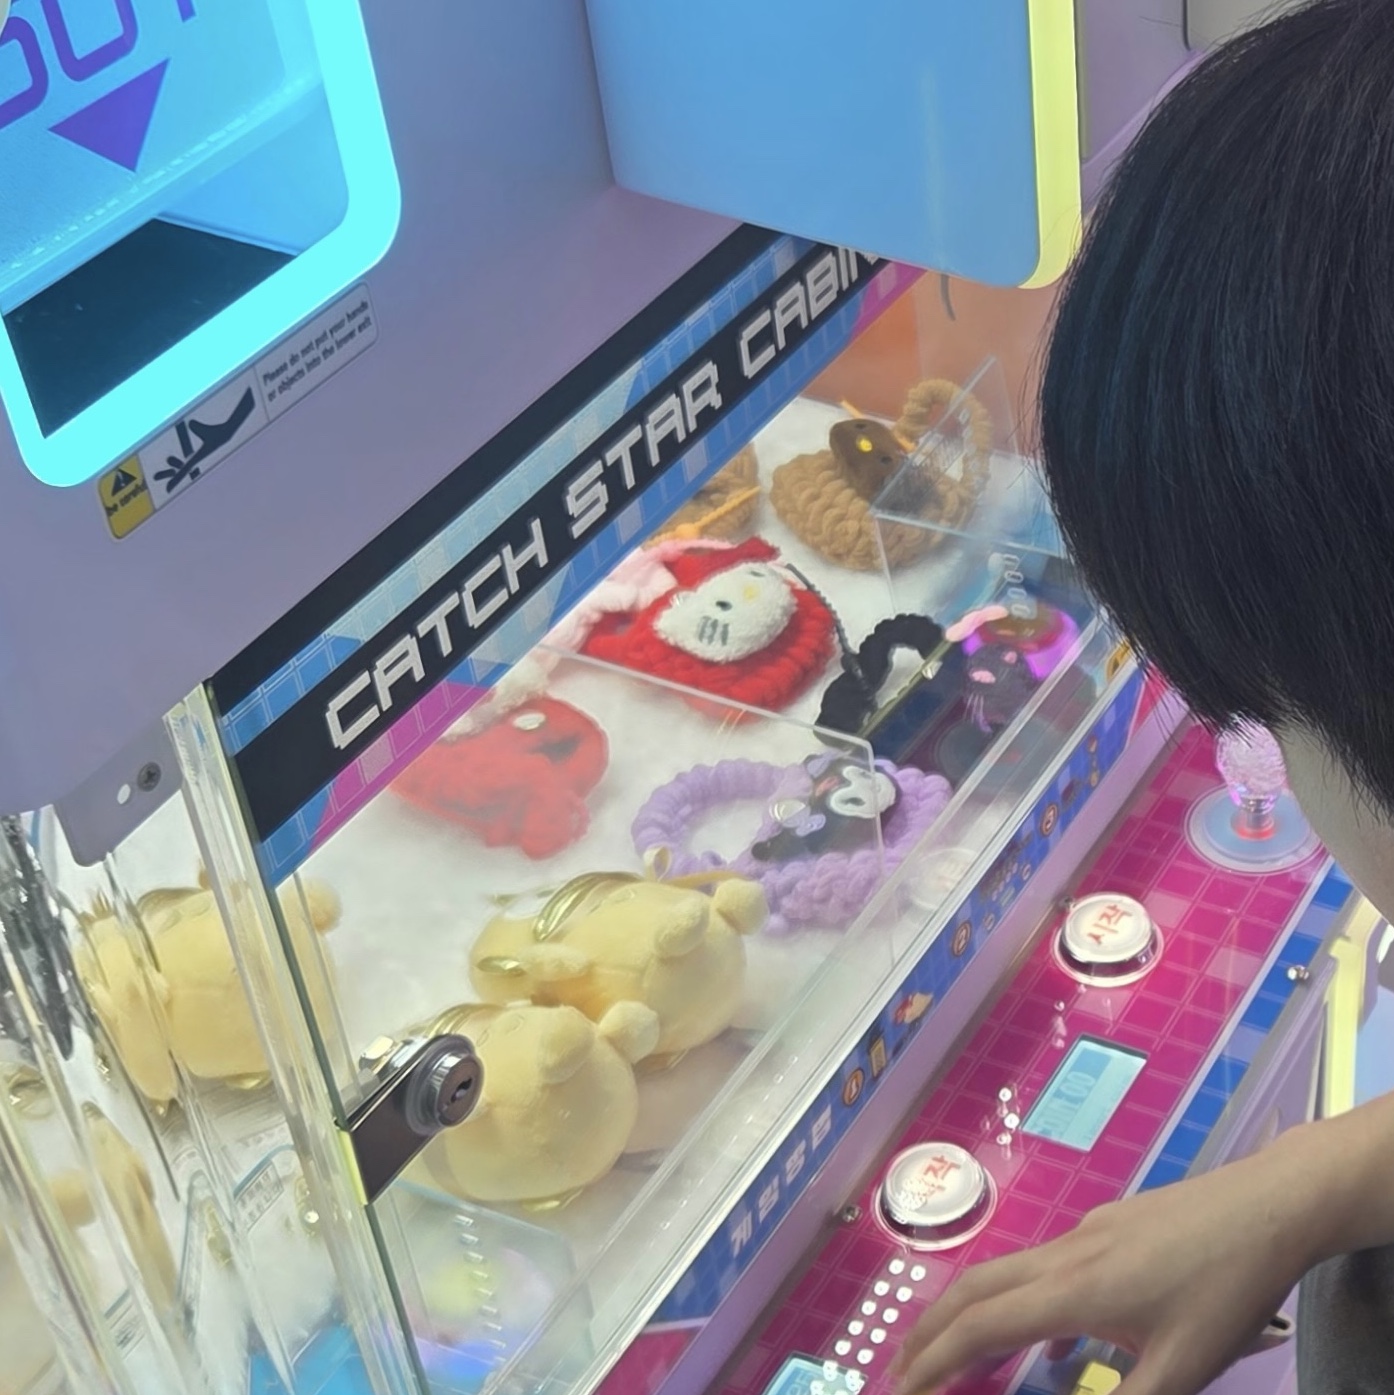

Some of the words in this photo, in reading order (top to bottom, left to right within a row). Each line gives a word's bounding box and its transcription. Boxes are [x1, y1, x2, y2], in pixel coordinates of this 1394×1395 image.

[263, 362, 288, 387] Please
[289, 353, 300, 367] do
[300, 341, 314, 358] not
[314, 330, 328, 350] put
[329, 318, 346, 338] your
[346, 300, 369, 323] hands
[267, 389, 276, 402] or
[277, 368, 305, 395] objects
[305, 356, 321, 373] into
[322, 345, 335, 360] the
[335, 329, 356, 350] lower
[358, 316, 372, 333] exit
[326, 518, 548, 749] CATCH
[566, 361, 722, 539] STAR
[1087, 904, 1133, 946] 시작
[731, 1104, 832, 1257] 게임방법
